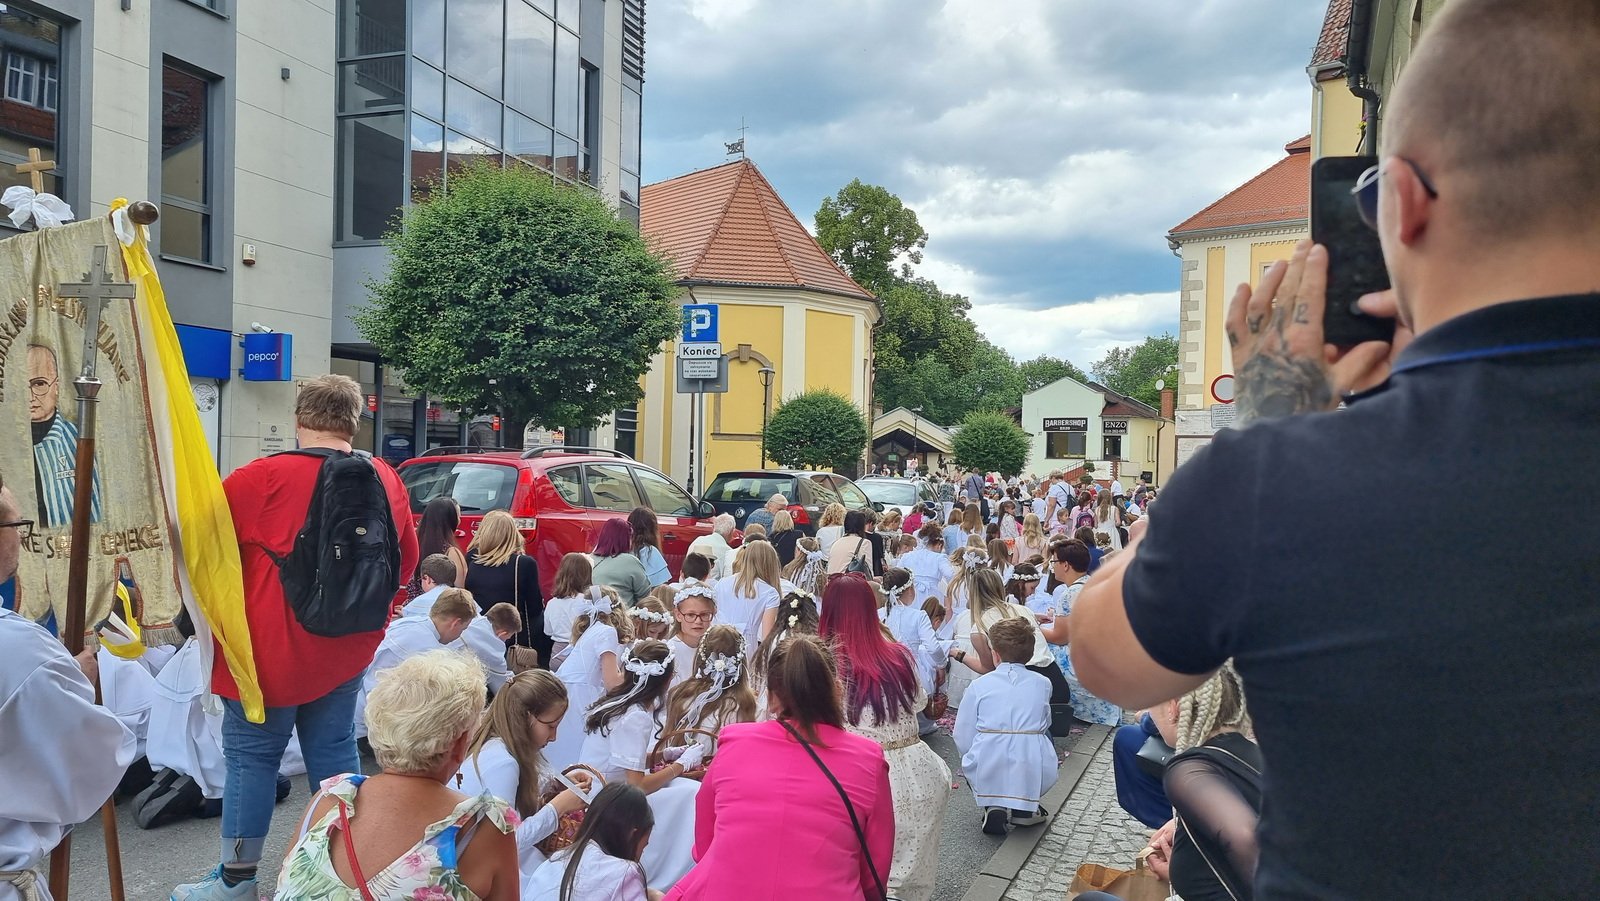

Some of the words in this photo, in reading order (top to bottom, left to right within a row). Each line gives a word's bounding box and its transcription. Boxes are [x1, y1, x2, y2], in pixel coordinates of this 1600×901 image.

[691, 309, 711, 338] P
[683, 346, 717, 356] Koniec
[248, 353, 277, 363] pepco
[1045, 420, 1086, 428] BARBERSHOP
